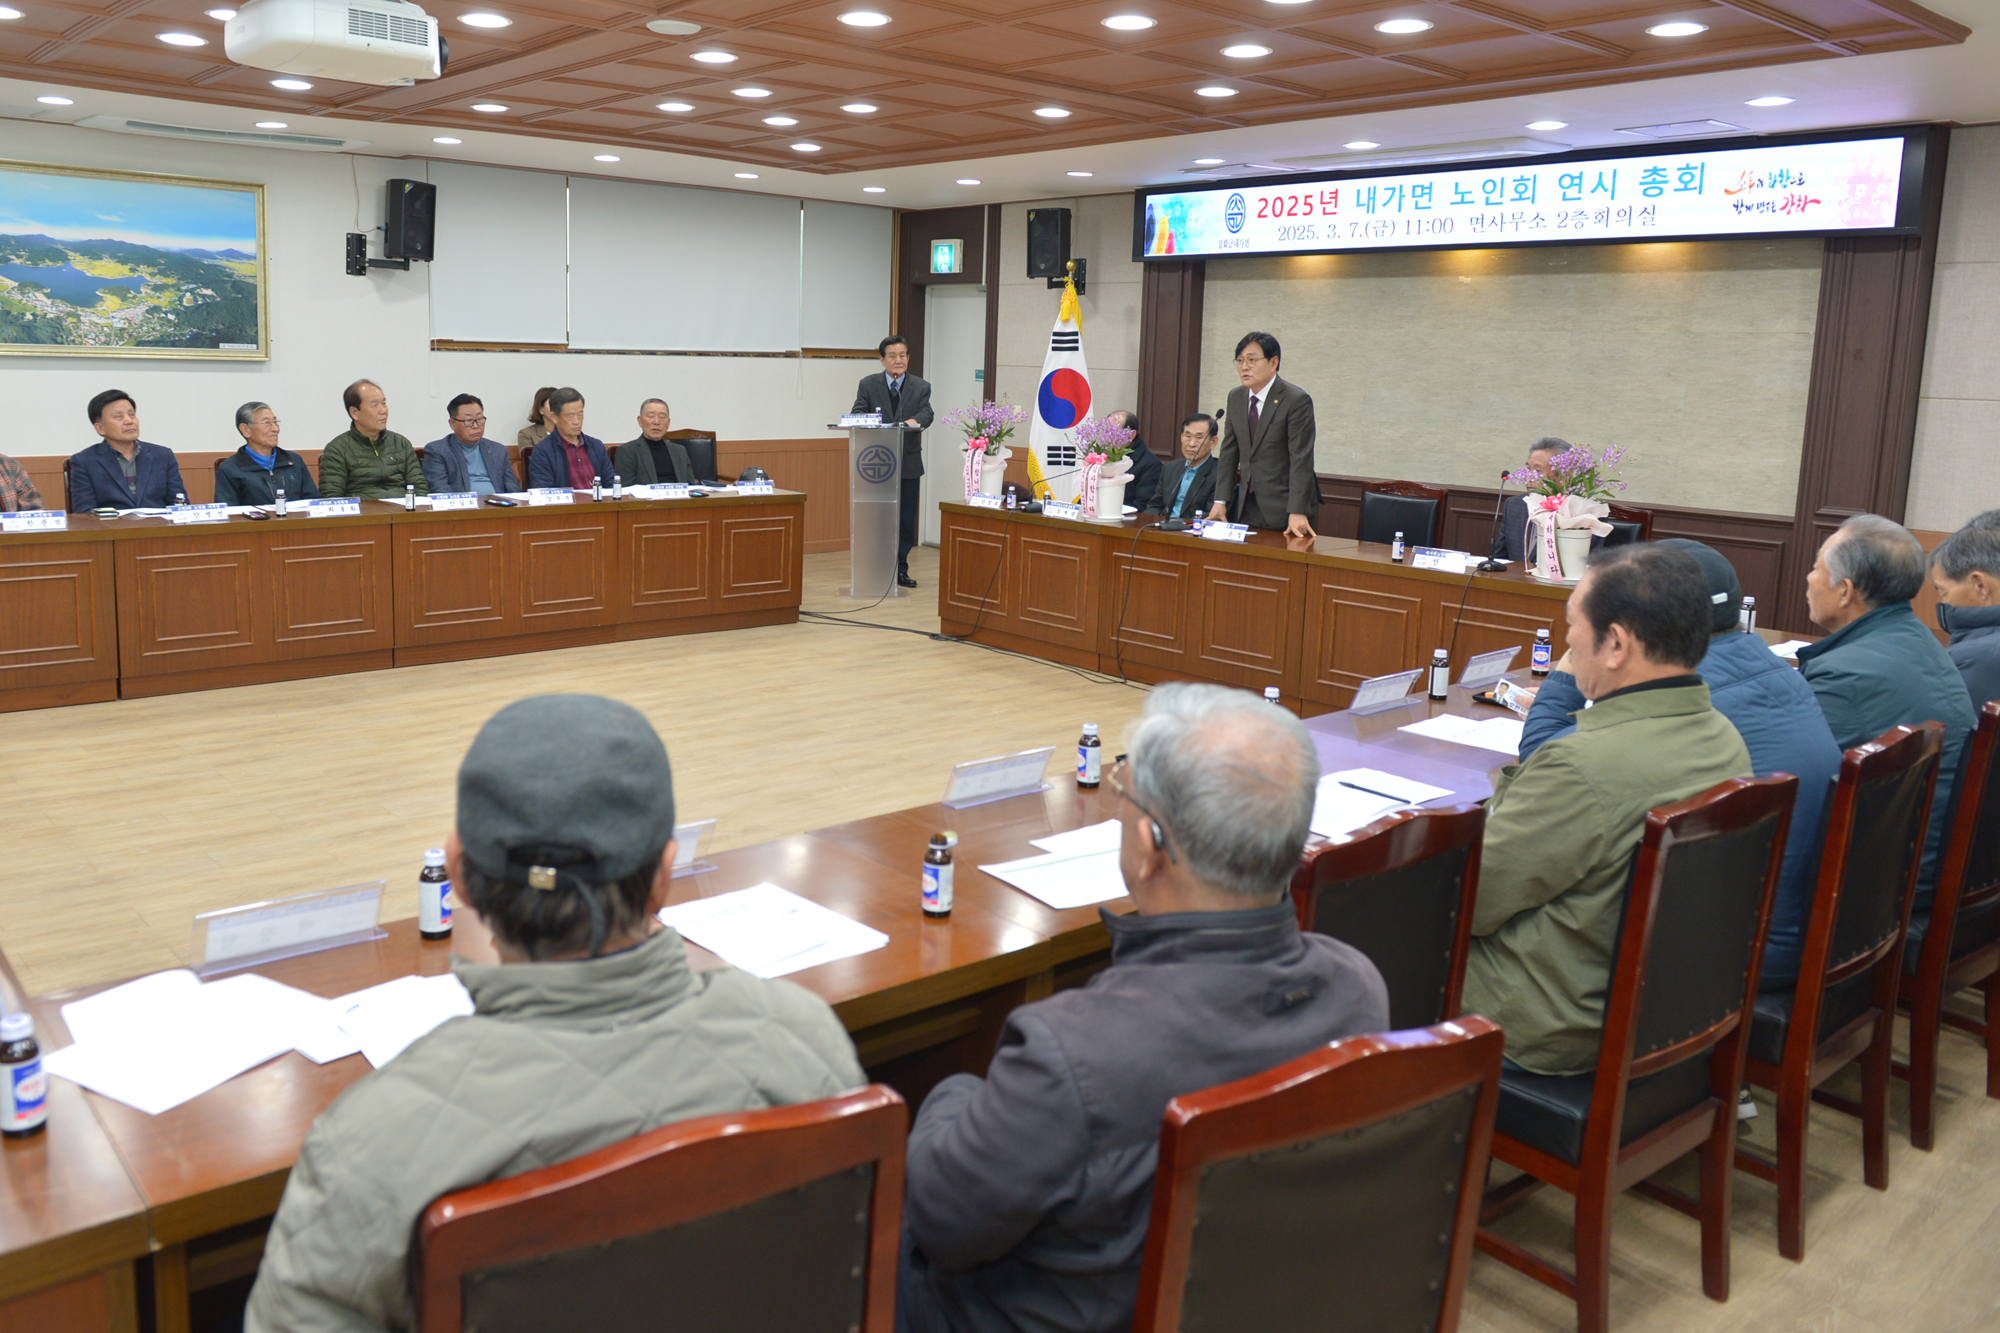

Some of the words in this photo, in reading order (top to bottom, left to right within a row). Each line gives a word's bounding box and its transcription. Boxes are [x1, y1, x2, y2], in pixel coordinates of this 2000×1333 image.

[1257, 188, 1338, 218] 2025년
[1356, 181, 1433, 214] 내가면
[1450, 173, 1537, 206] 노인회
[1558, 168, 1617, 201] 연시
[1638, 161, 1705, 198] 총회
[1278, 224, 1320, 241] 2025.
[1327, 224, 1341, 239] 3.
[1349, 219, 1396, 238] 7.(금)
[1405, 217, 1454, 235] 11:00
[1470, 212, 1547, 233] 면사무소
[1557, 204, 1657, 229] 2층회의실
